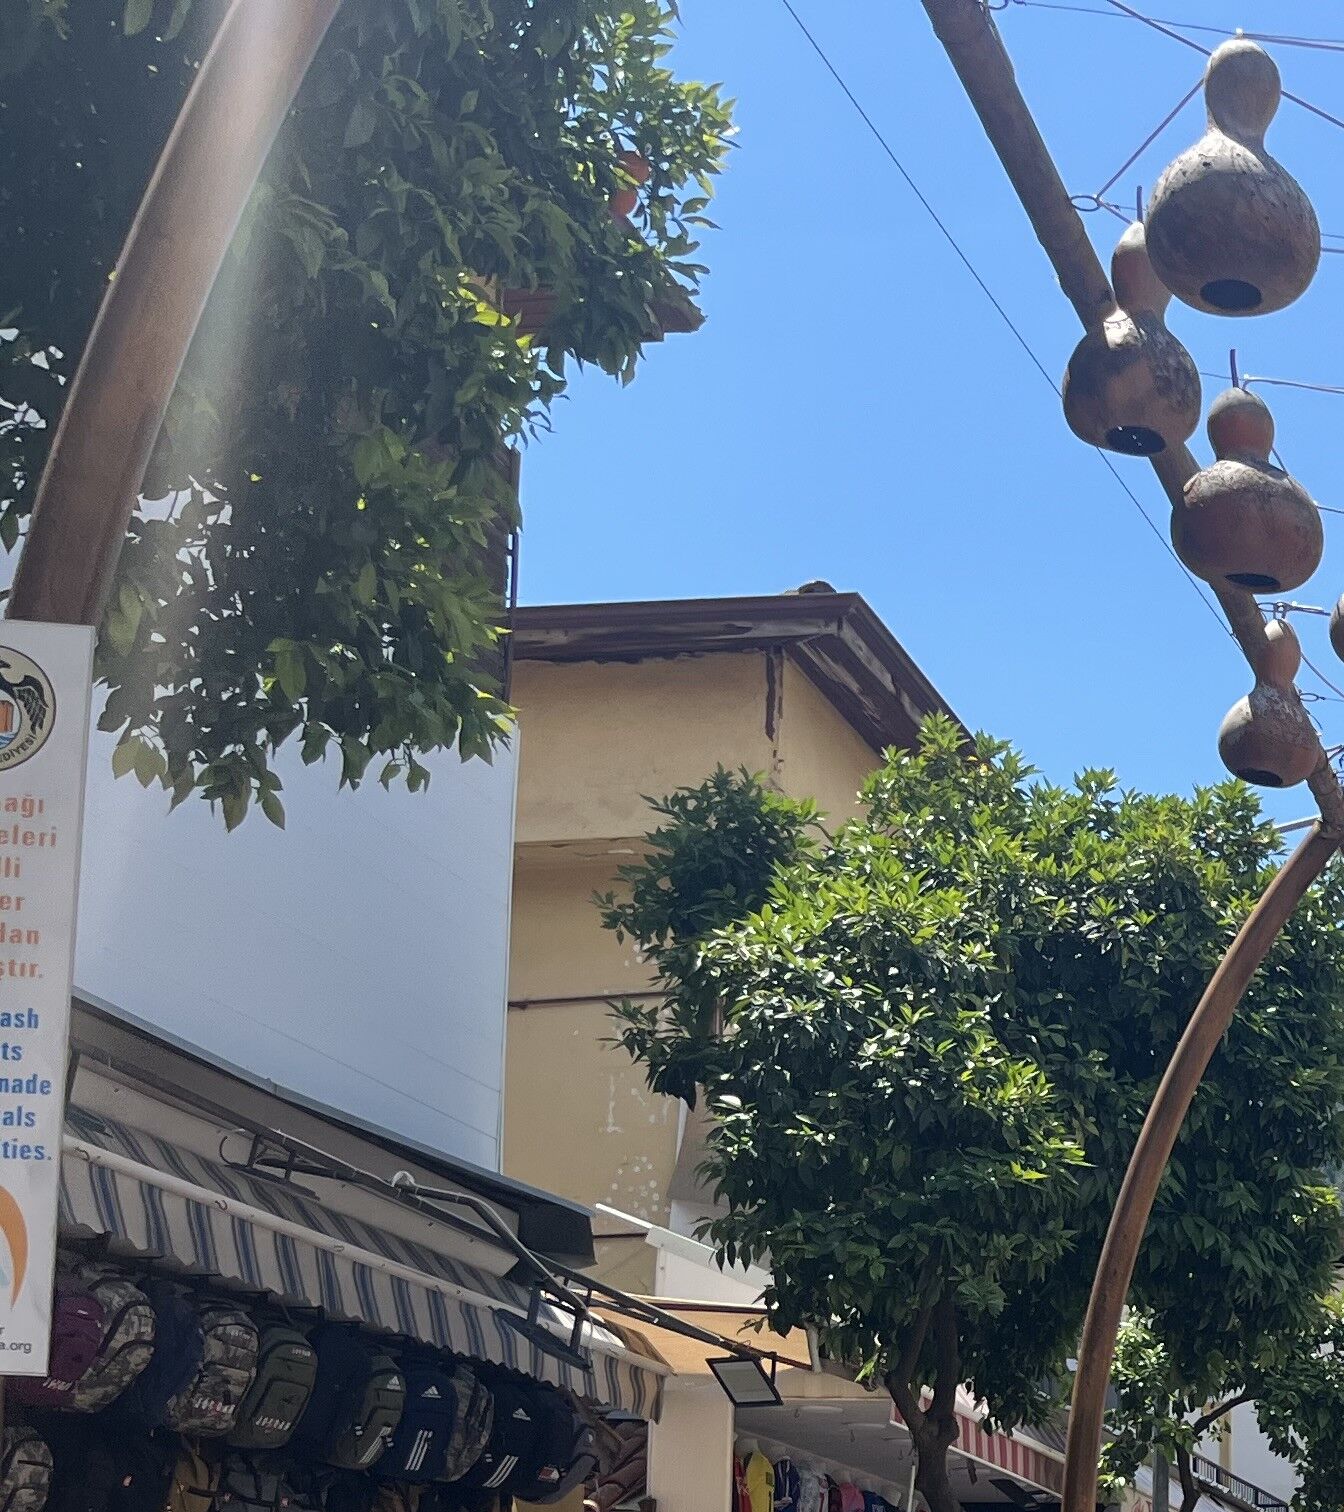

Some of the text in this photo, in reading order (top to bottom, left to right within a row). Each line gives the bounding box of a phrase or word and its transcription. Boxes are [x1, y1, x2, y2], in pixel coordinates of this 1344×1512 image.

[0, 1007, 39, 1029] ash
[2, 1042, 22, 1062] ts
[3, 1106, 36, 1127] als
